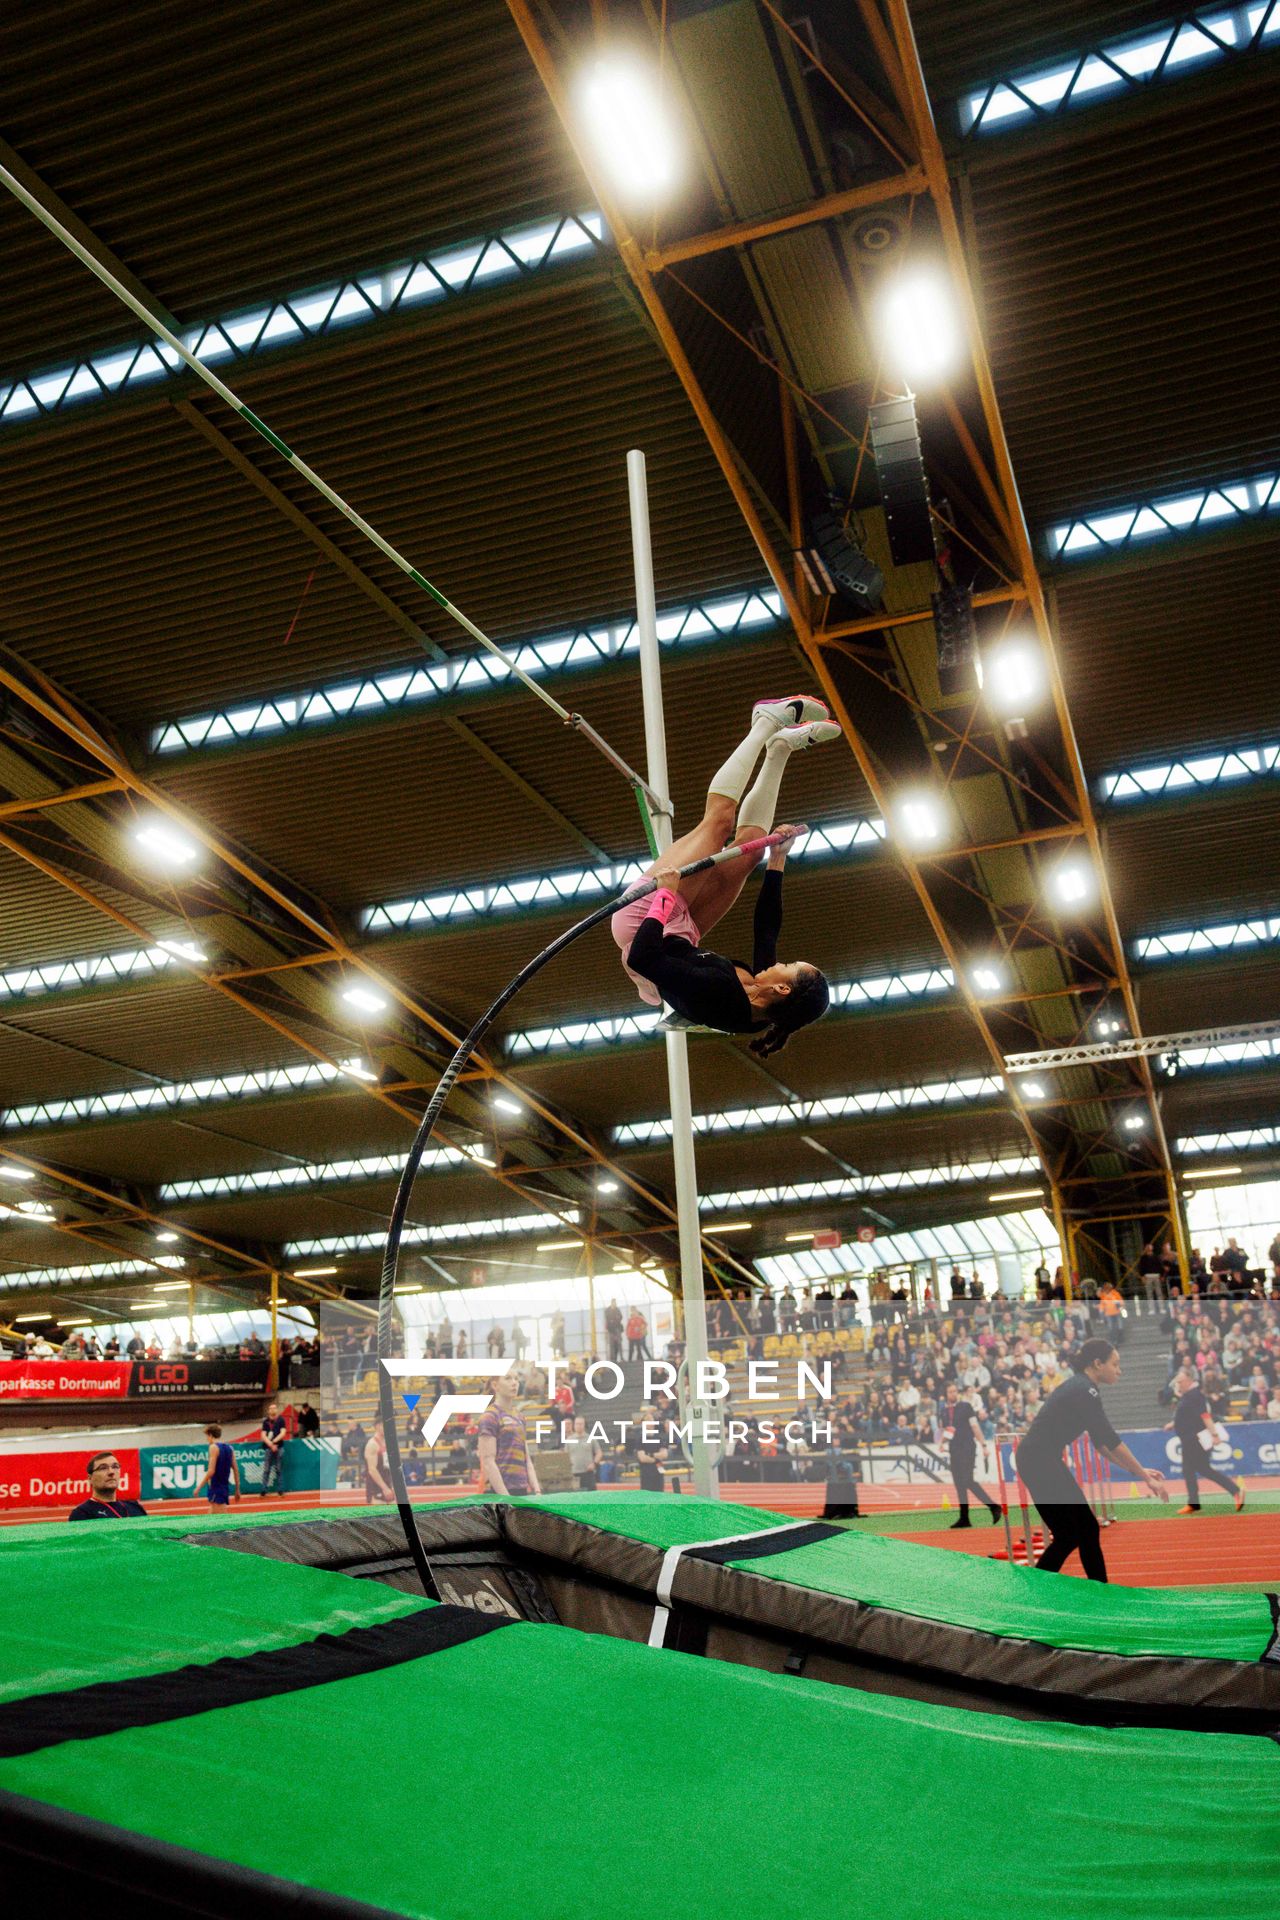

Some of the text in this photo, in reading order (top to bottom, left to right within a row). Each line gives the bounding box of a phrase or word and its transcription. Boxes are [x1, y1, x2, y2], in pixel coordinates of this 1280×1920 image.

[60, 1376, 121, 1390] Dortmund
[139, 1384, 189, 1393] DORTMUND
[29, 1472, 129, 1497] Dortmd
